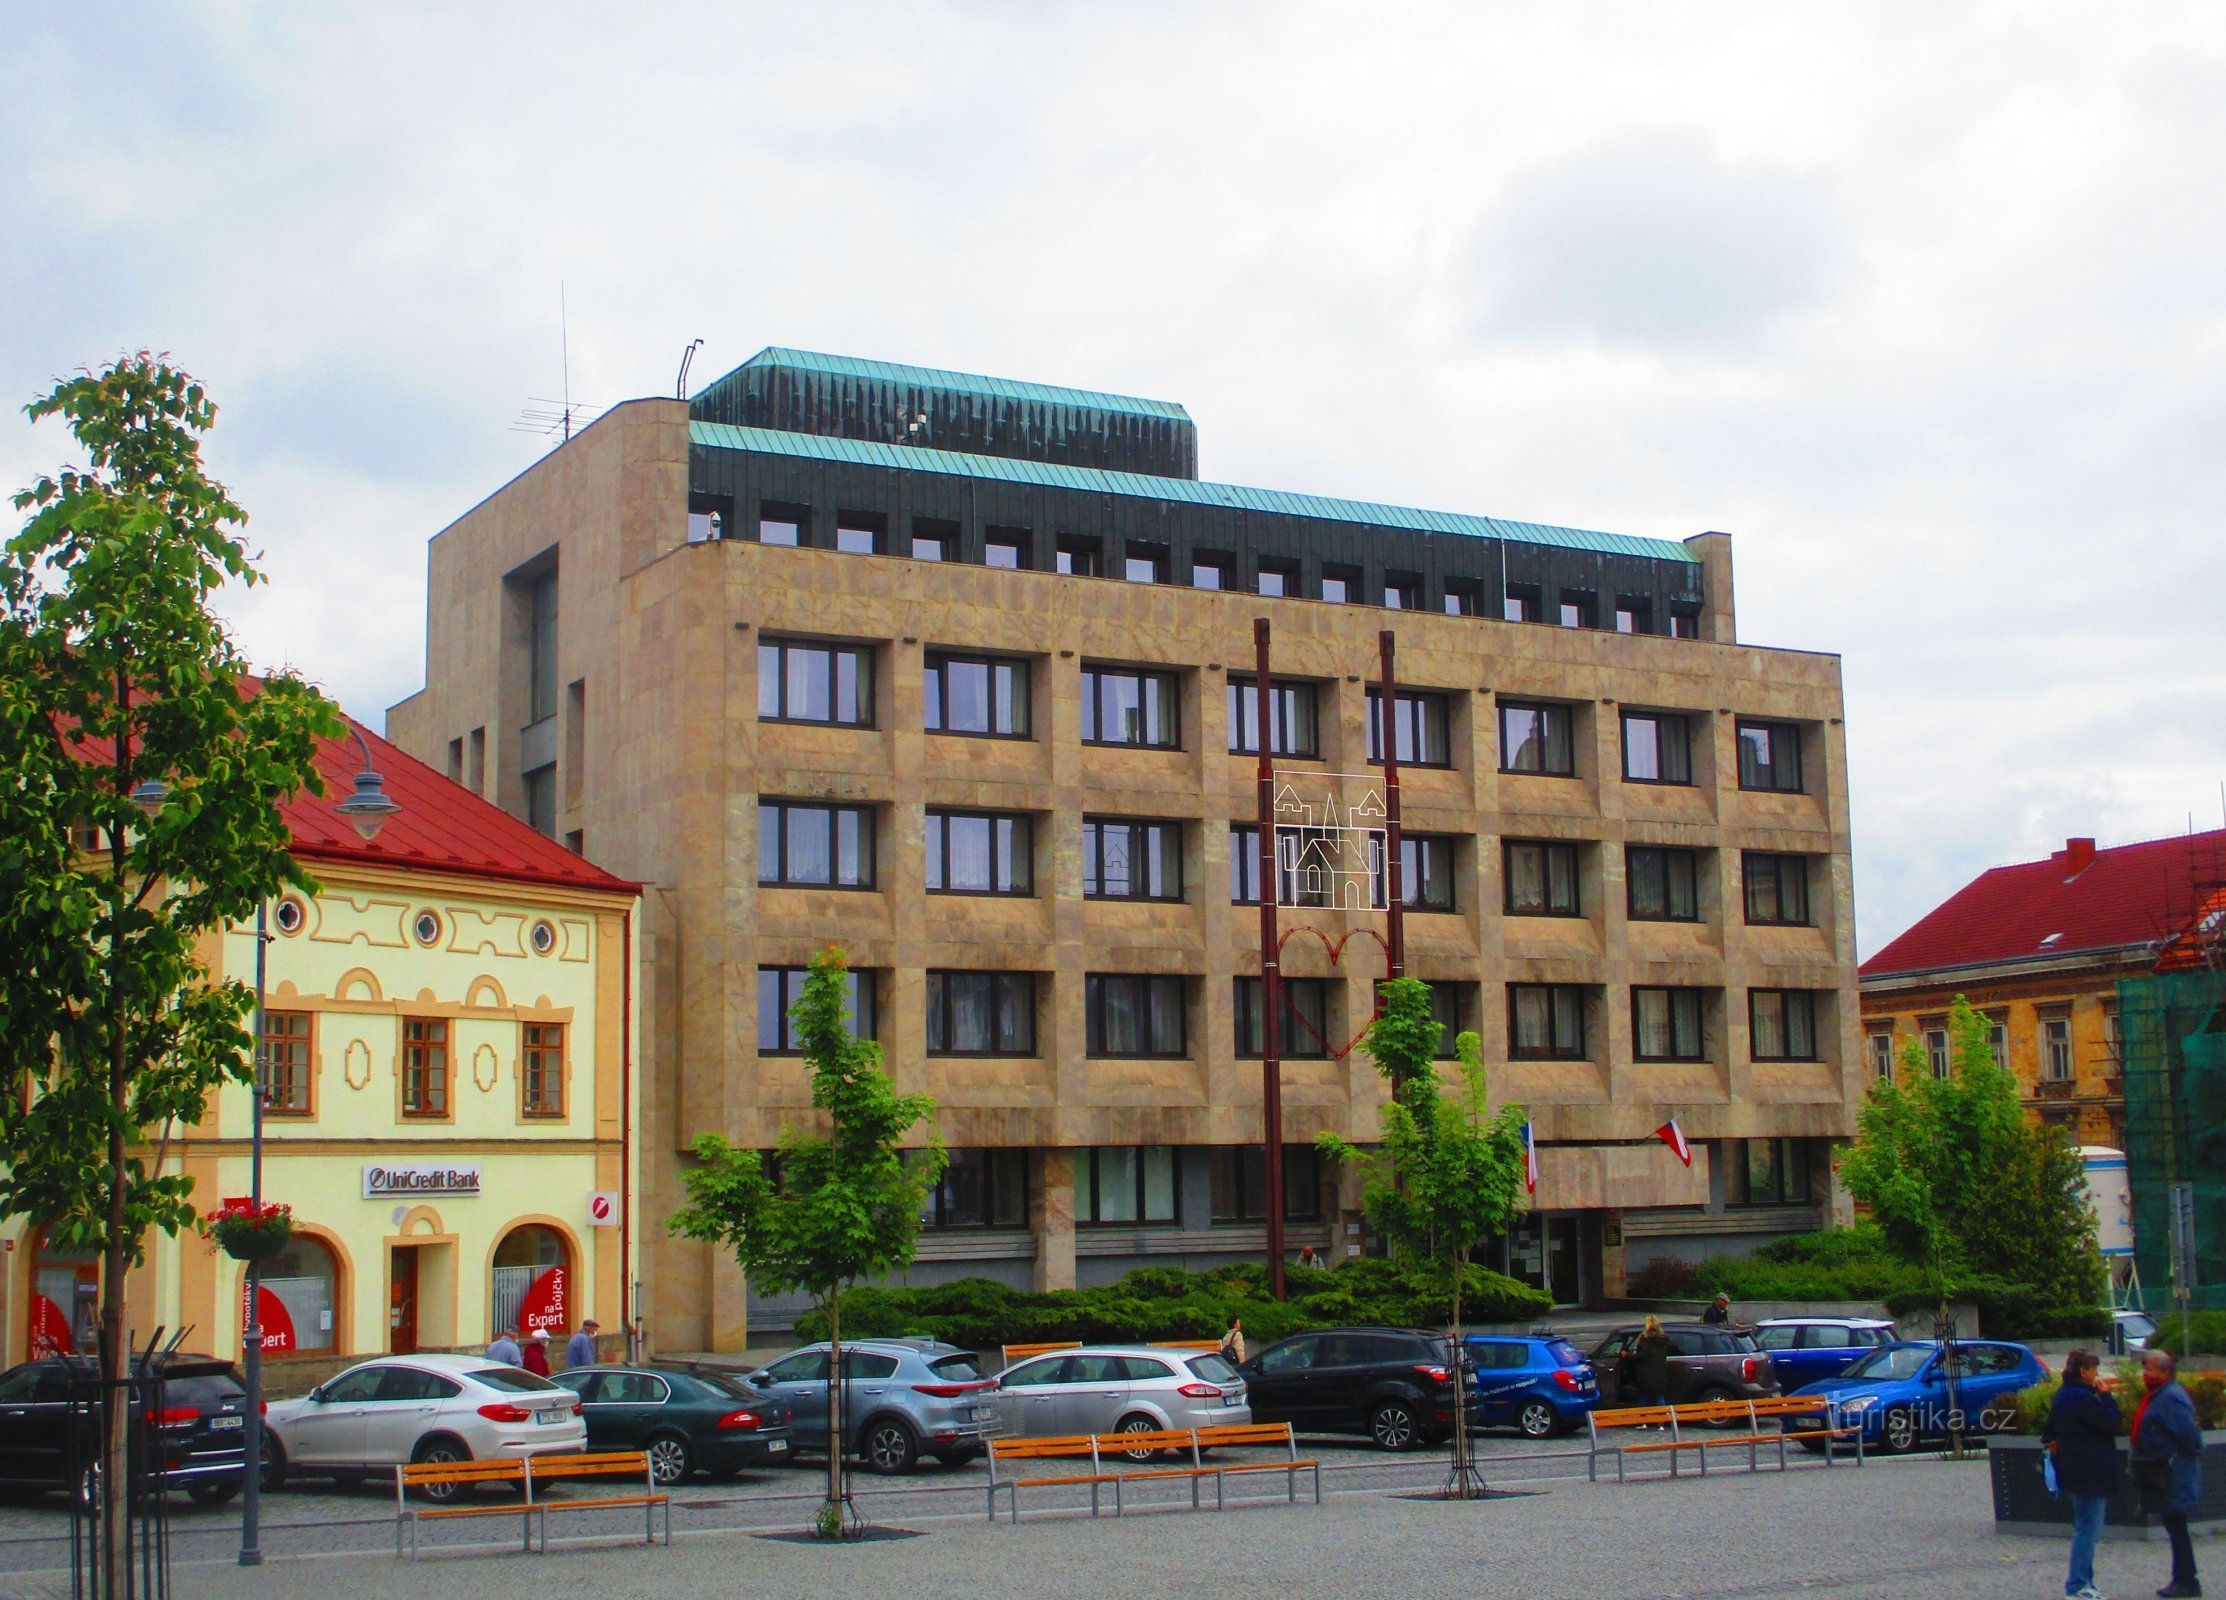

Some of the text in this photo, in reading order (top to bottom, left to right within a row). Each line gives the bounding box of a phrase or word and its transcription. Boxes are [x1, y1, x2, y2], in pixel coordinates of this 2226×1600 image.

[386, 1169, 480, 1189] UniCredit Bank
[552, 1268, 564, 1311] půjčky
[544, 1305, 555, 1314] na
[528, 1312, 564, 1330] Expert
